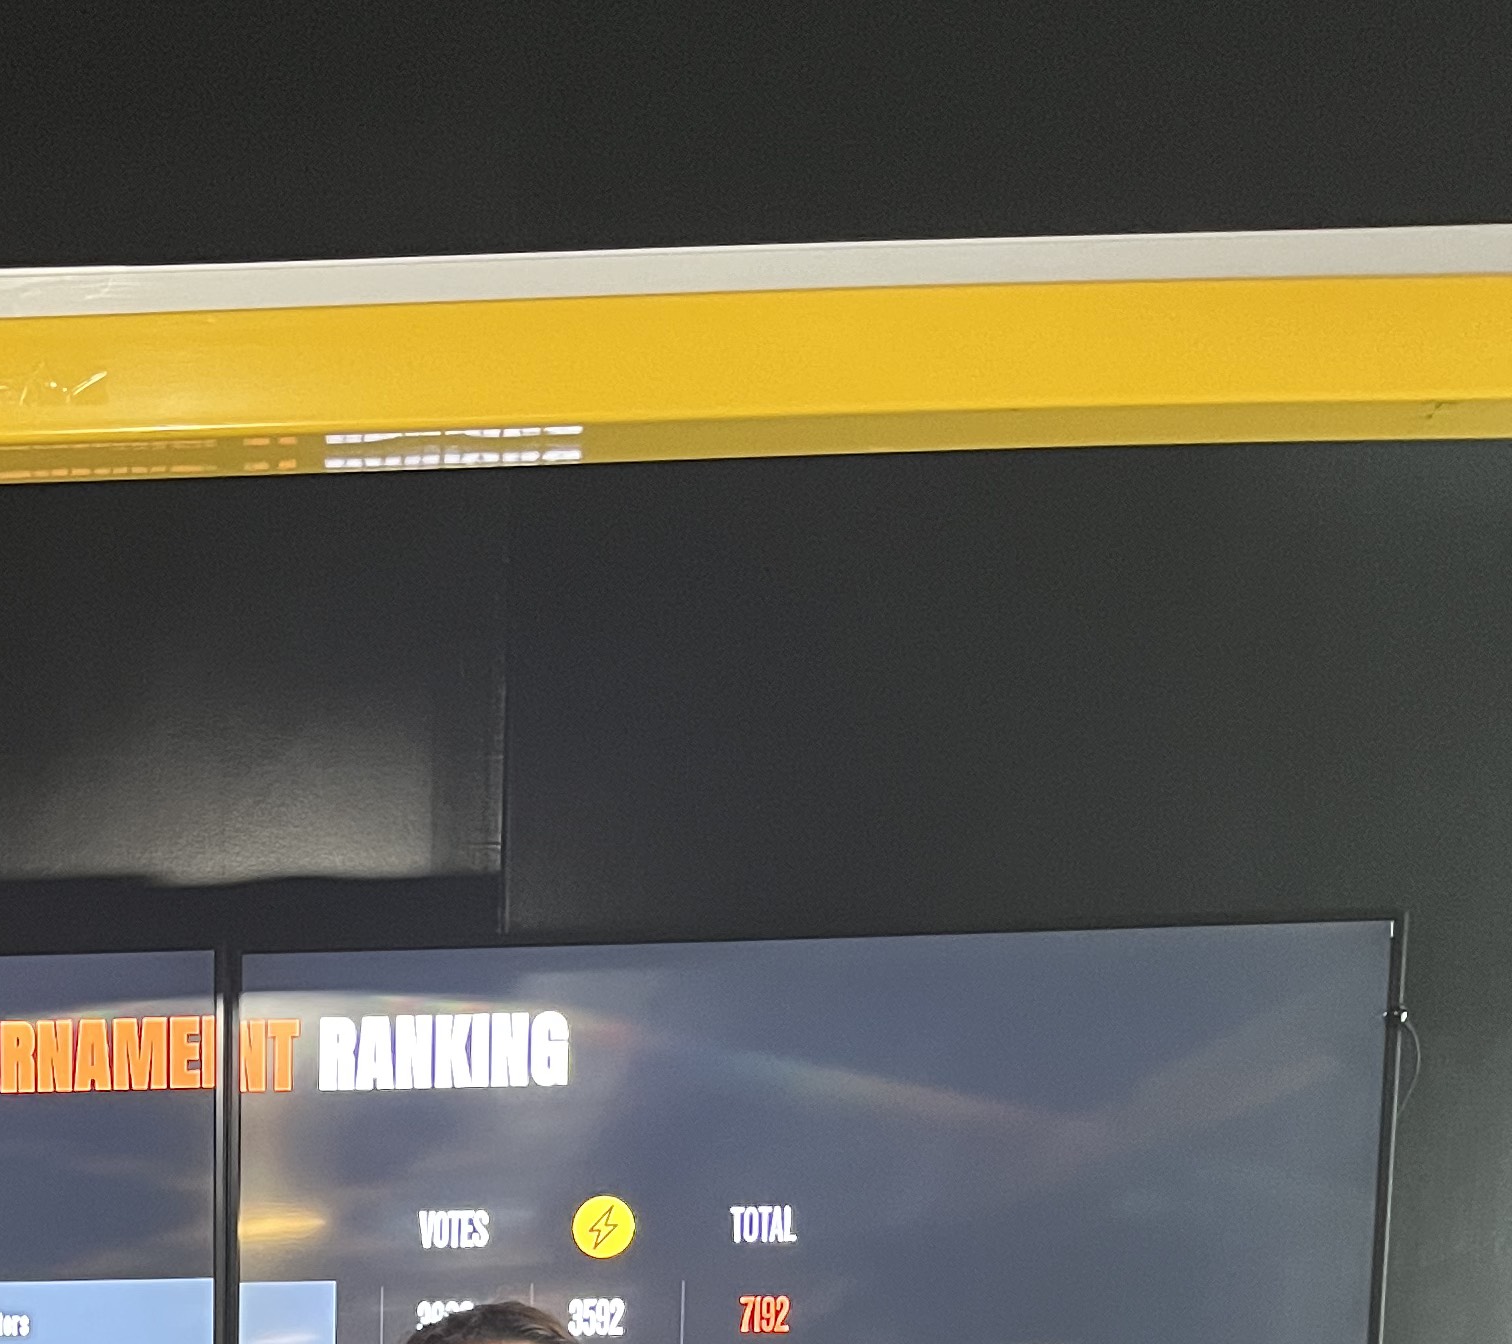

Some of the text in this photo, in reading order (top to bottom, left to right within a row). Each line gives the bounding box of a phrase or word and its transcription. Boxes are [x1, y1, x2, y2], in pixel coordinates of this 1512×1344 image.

[318, 1010, 571, 1091] RANKING
[418, 1209, 490, 1249] VOTES
[729, 1204, 798, 1244] TOTAL
[567, 1297, 627, 1338] 3592
[738, 1295, 790, 1334] 7192
